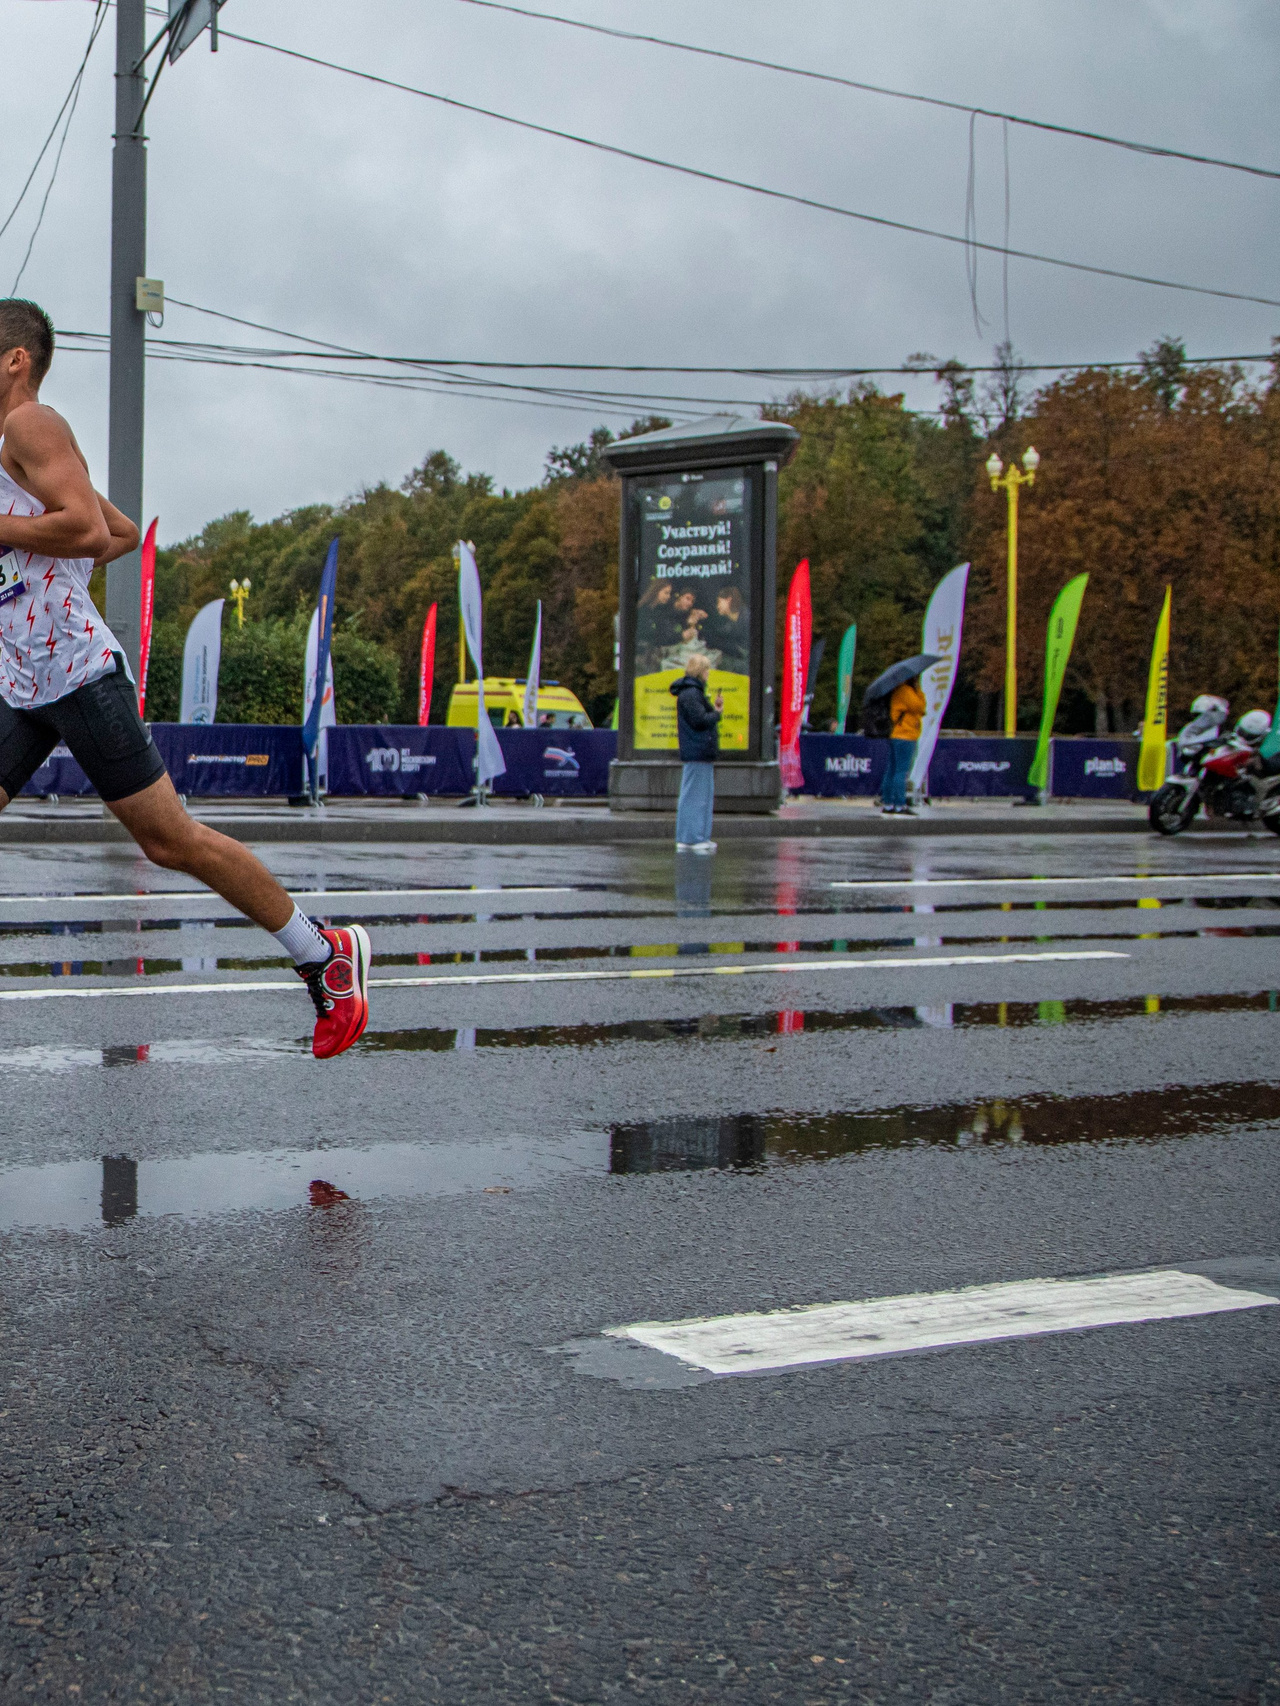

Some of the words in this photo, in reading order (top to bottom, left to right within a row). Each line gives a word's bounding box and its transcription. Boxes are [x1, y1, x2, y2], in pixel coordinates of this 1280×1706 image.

[662, 521, 731, 539] Участвуй!
[657, 540, 731, 560] Сохраняй!
[656, 560, 732, 578] Побеждай!
[957, 761, 1011, 771] POWERUP
